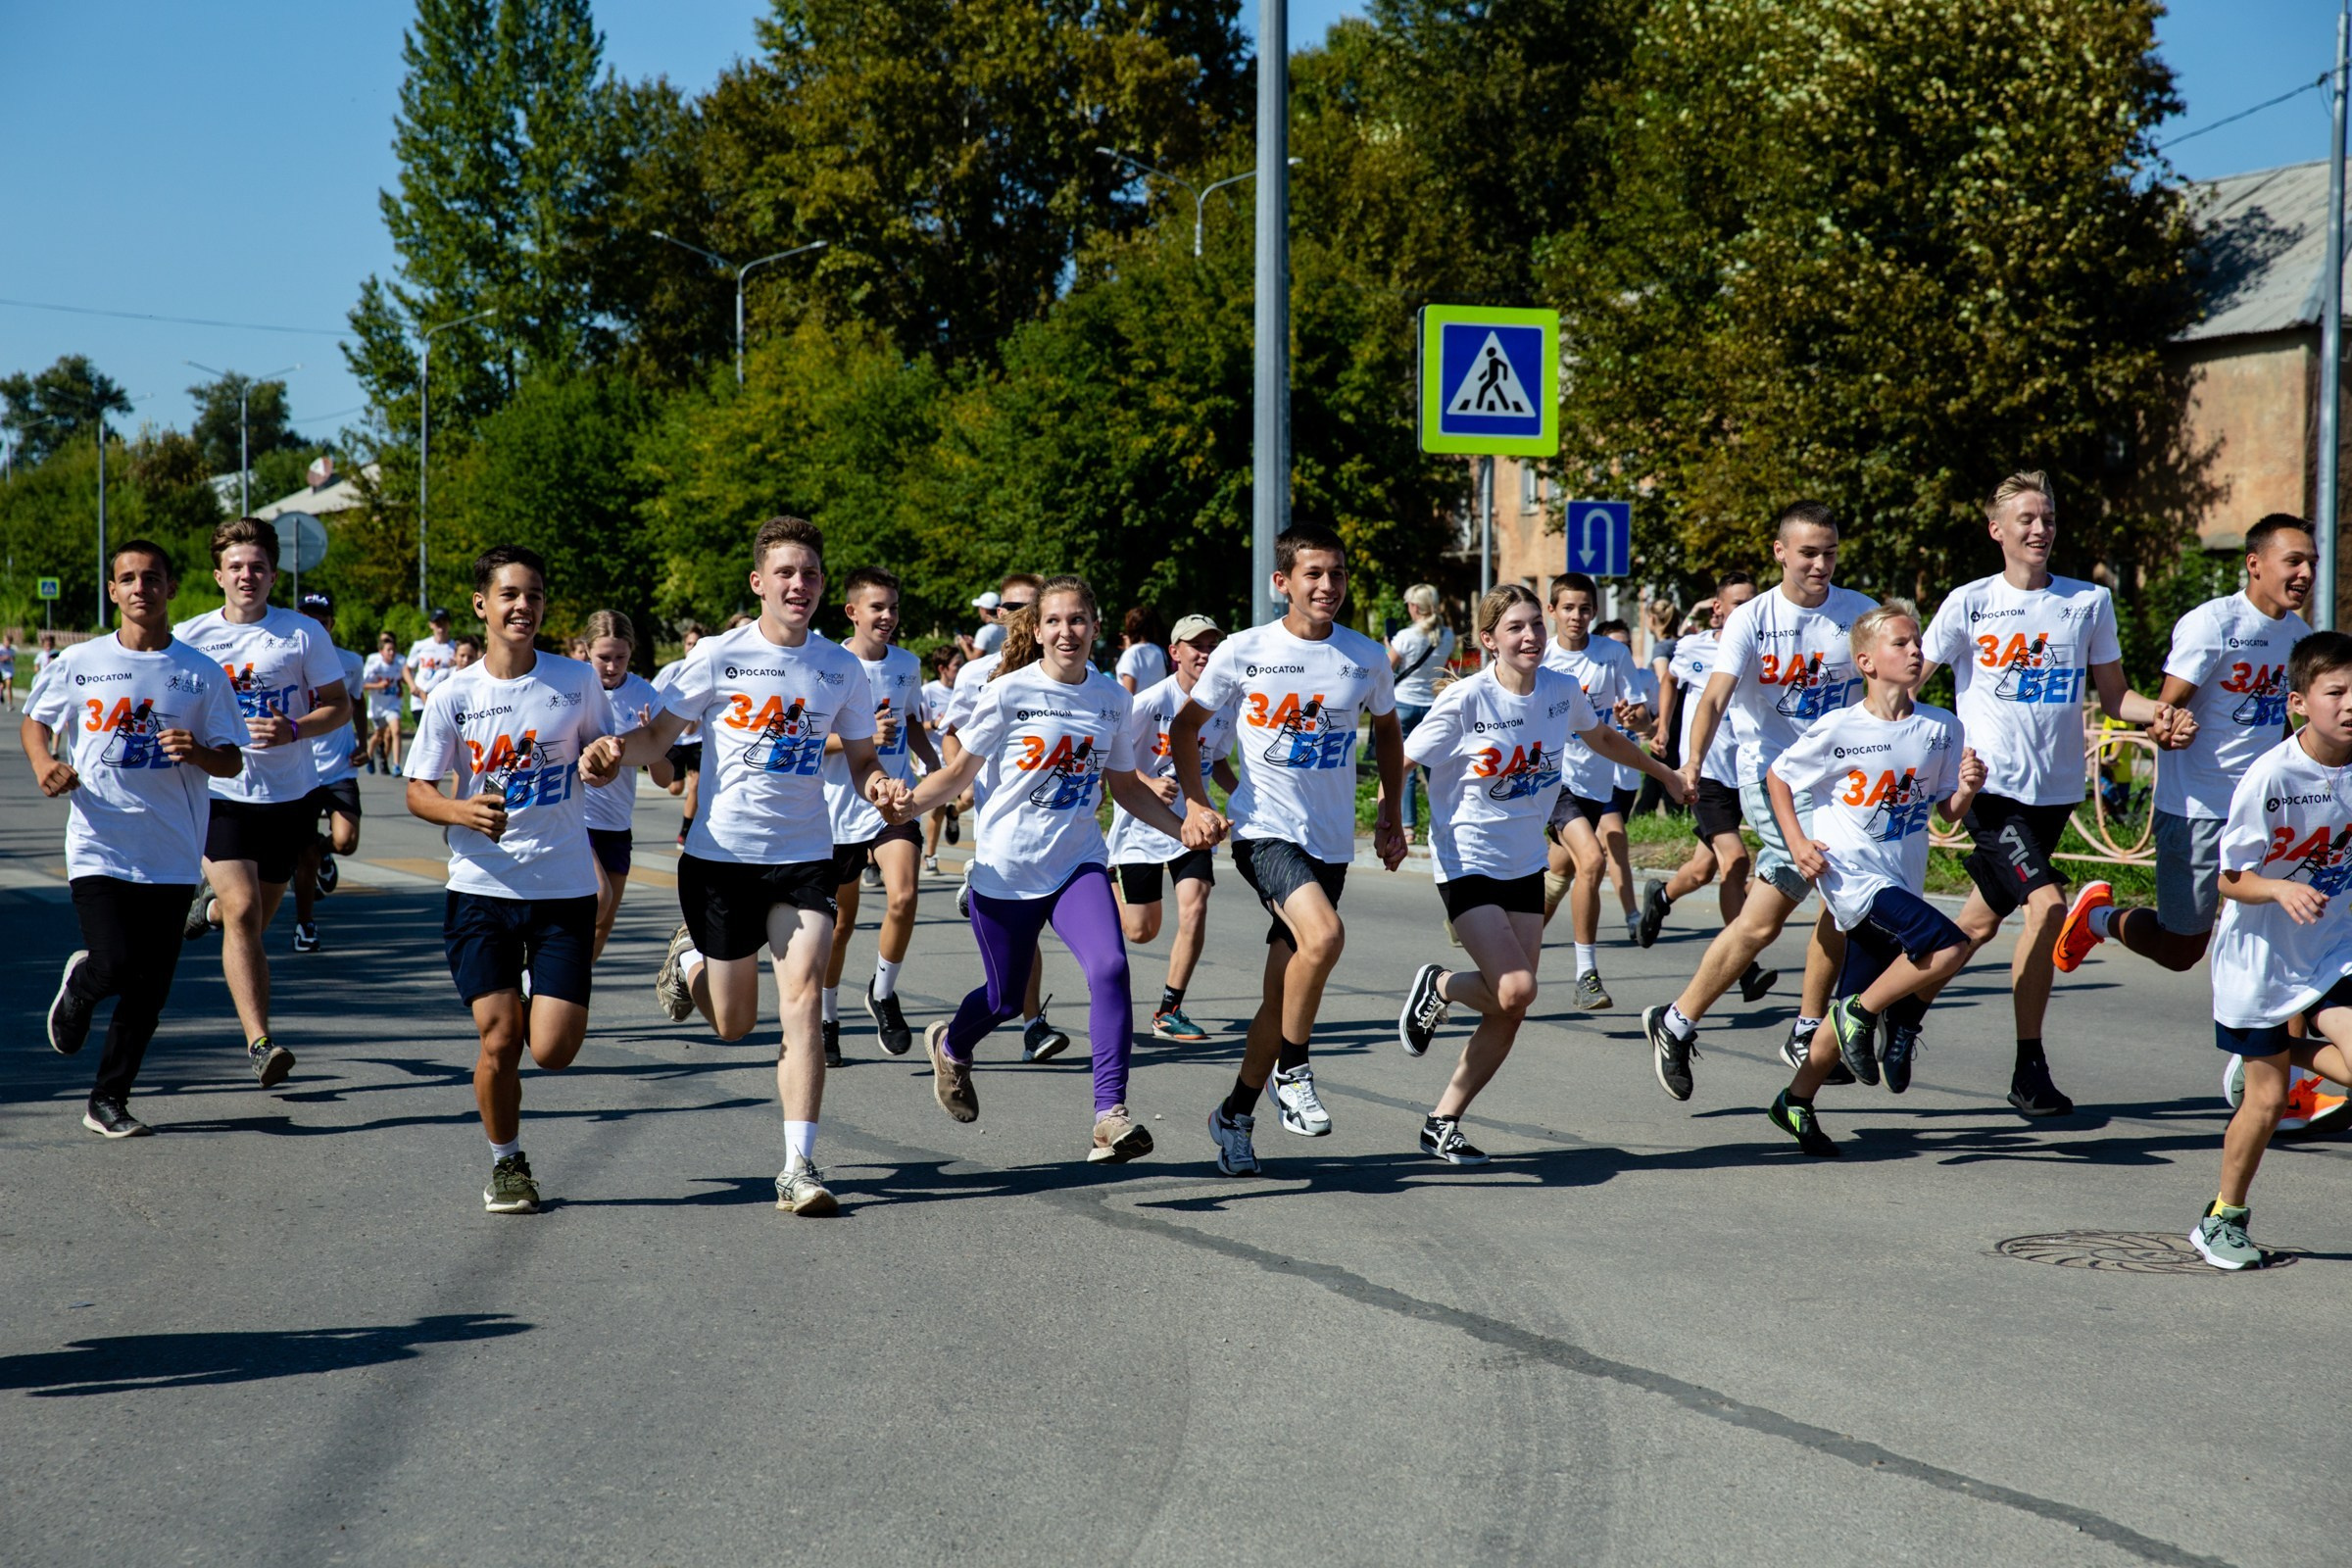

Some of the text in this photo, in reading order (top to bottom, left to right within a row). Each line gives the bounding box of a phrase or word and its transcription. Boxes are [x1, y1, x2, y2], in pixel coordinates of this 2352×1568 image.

[305, 594, 329, 607] FILA
[1982, 609, 2026, 620] РОСАТОМ
[1977, 632, 2049, 667] ЗА!
[86, 672, 132, 683] РОСАТОМ
[739, 668, 786, 677] РОСАТОМ
[1258, 665, 1305, 675] РОСАТОМ
[1758, 652, 1825, 687] ЗА!
[2016, 667, 2085, 704] БЕГ
[2219, 662, 2285, 696] ЗА!
[85, 697, 154, 733] ЗА!
[467, 705, 513, 721] РОСАТОМ
[723, 693, 806, 735] ЗА!
[1030, 709, 1073, 717] РОСАТОМ
[1246, 692, 1325, 731] ЗА!
[1015, 735, 1095, 773] ЗА!
[1288, 731, 1357, 769] БЕГ
[1473, 741, 1542, 778] ЗА!
[1846, 744, 1892, 756] РОСАТОМ
[1841, 767, 1917, 808] ЗА!
[1999, 824, 2039, 882] FILA
